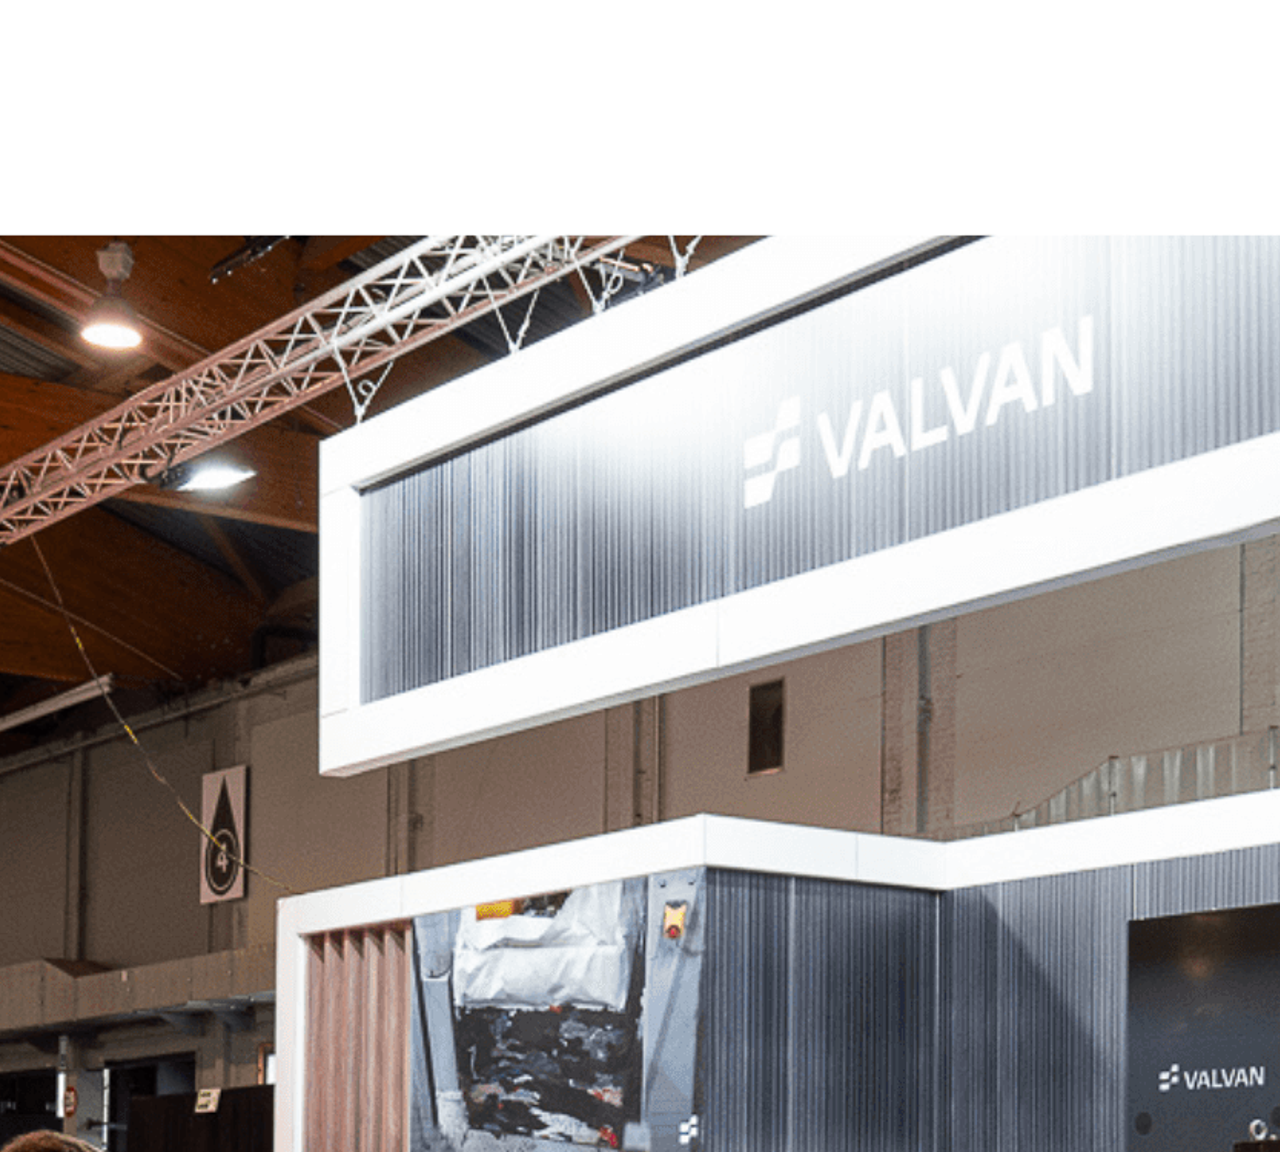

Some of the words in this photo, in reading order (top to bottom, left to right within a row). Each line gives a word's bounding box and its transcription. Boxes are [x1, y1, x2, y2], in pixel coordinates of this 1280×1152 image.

[817, 315, 1094, 480] VALVAN
[216, 843, 229, 873] 4
[1183, 1066, 1265, 1090] VALVAN
